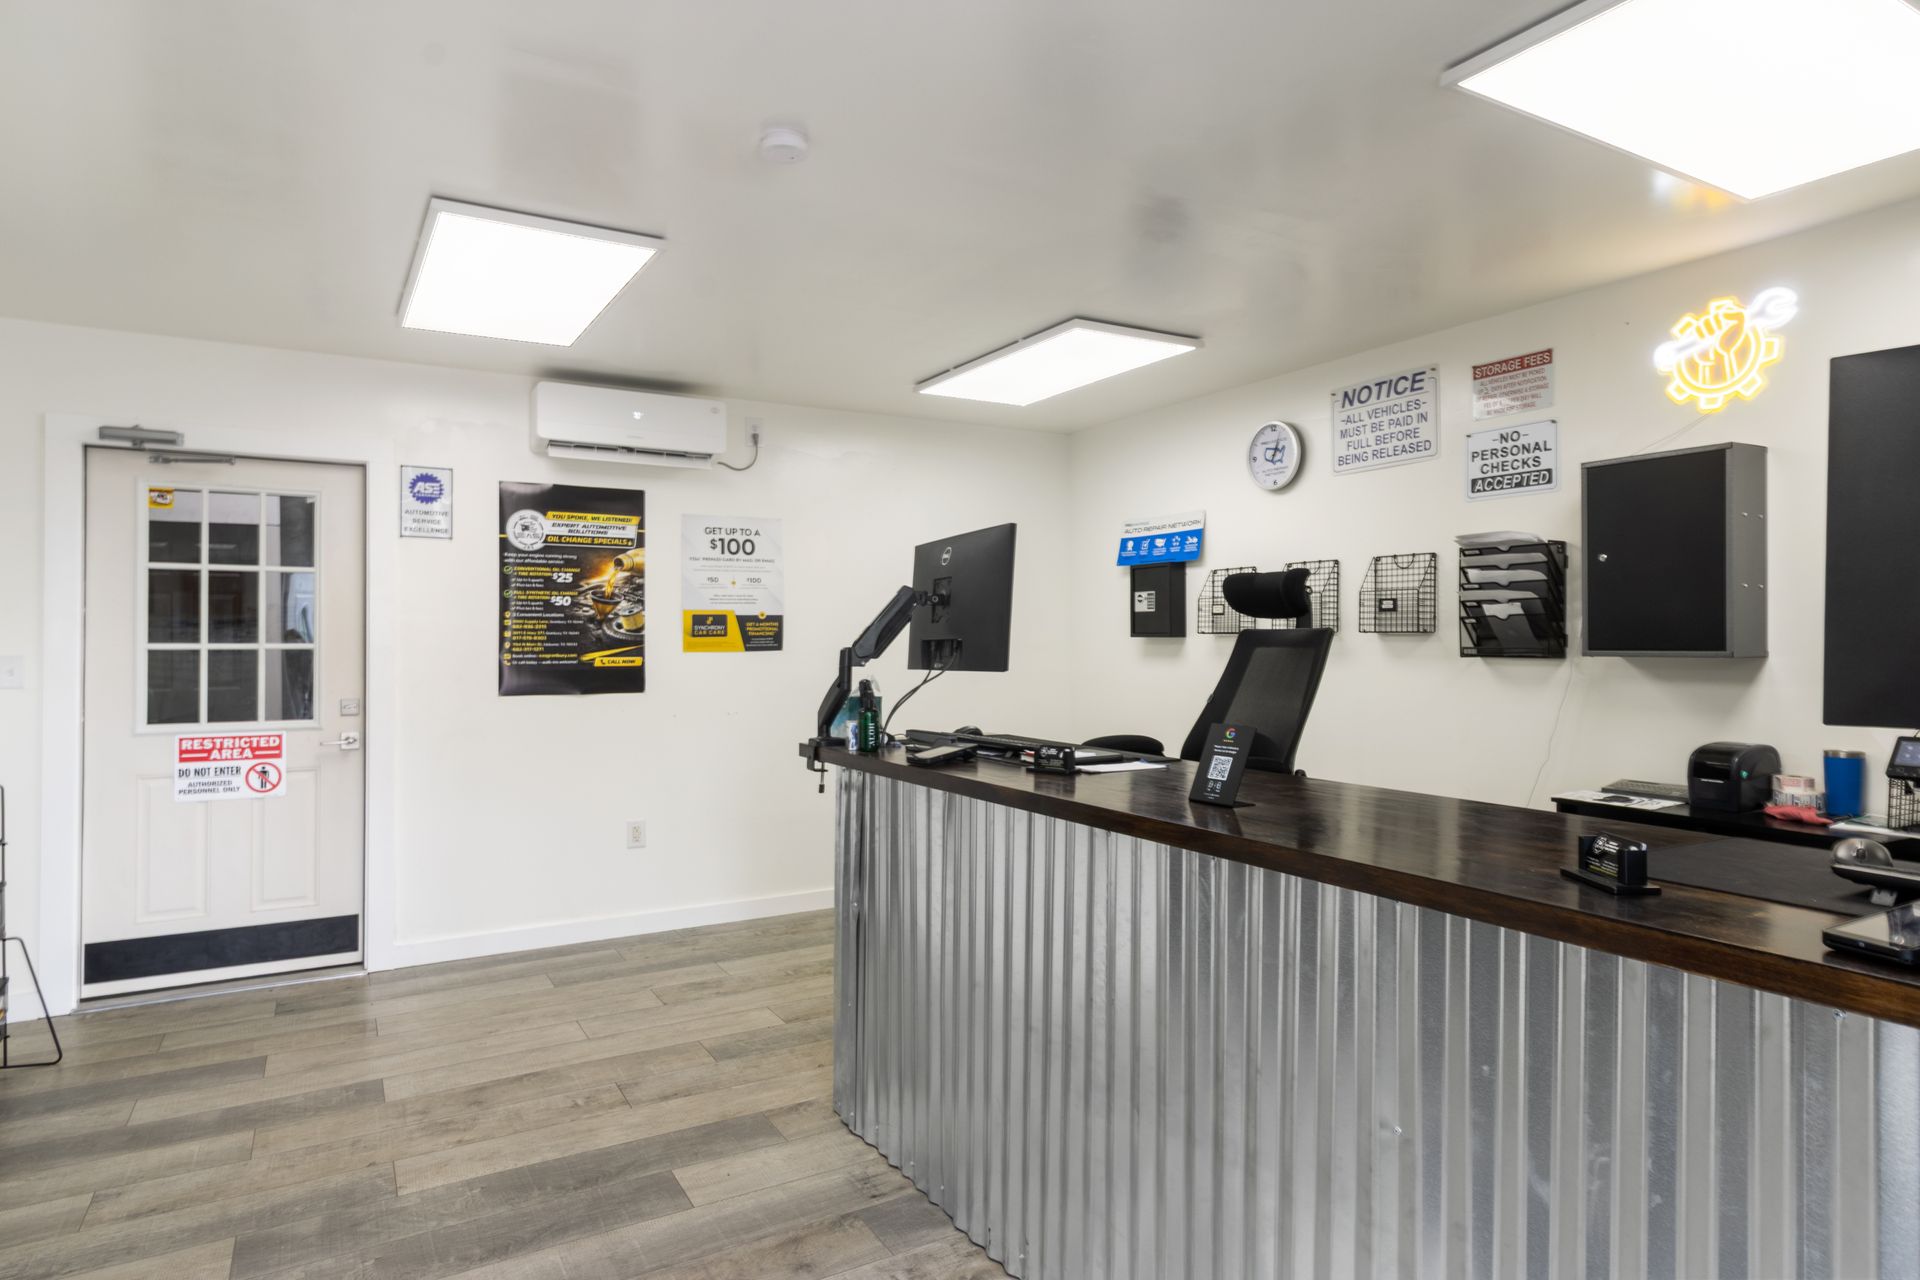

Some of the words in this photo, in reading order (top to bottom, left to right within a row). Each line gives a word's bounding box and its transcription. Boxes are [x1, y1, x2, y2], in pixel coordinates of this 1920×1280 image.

[1475, 359, 1522, 378] STORAGE
[1524, 352, 1551, 367] FEES
[1341, 371, 1426, 409] NOTICE
[1340, 424, 1368, 439] MUST
[1371, 420, 1385, 433] BE
[1388, 414, 1413, 430] PAID
[1417, 411, 1428, 424] IN
[1347, 437, 1372, 451] FULL
[1375, 427, 1420, 446] BEFORE
[1338, 451, 1369, 467] BEING
[1371, 439, 1432, 460] RELEASED
[1471, 440, 1553, 463] PERSONAL
[1480, 455, 1542, 475] CHECKS
[1474, 470, 1550, 492] ACCEPTED
[413, 482, 440, 494] ASE
[404, 509, 449, 517] AUTOMOTIVE
[404, 526, 449, 534] EXCELLENCE
[704, 526, 723, 535] GET
[725, 527, 738, 536] UP
[740, 528, 752, 537] TO
[754, 529, 761, 537] A
[1144, 524, 1167, 532] REPAIR
[1168, 519, 1201, 529] NETWORK
[562, 536, 592, 544] CHANGE
[594, 537, 628, 546] SPECIALS
[710, 537, 756, 556] $100
[552, 572, 574, 583] $25
[550, 595, 572, 607] $50
[181, 736, 280, 750] RESTRICTED
[209, 748, 253, 760] AREA
[178, 768, 191, 778] DO
[194, 767, 211, 777] NOT
[214, 766, 241, 777] ENTER
[187, 780, 233, 788] AUTHORIZED
[178, 787, 220, 796] PERSONNEL
